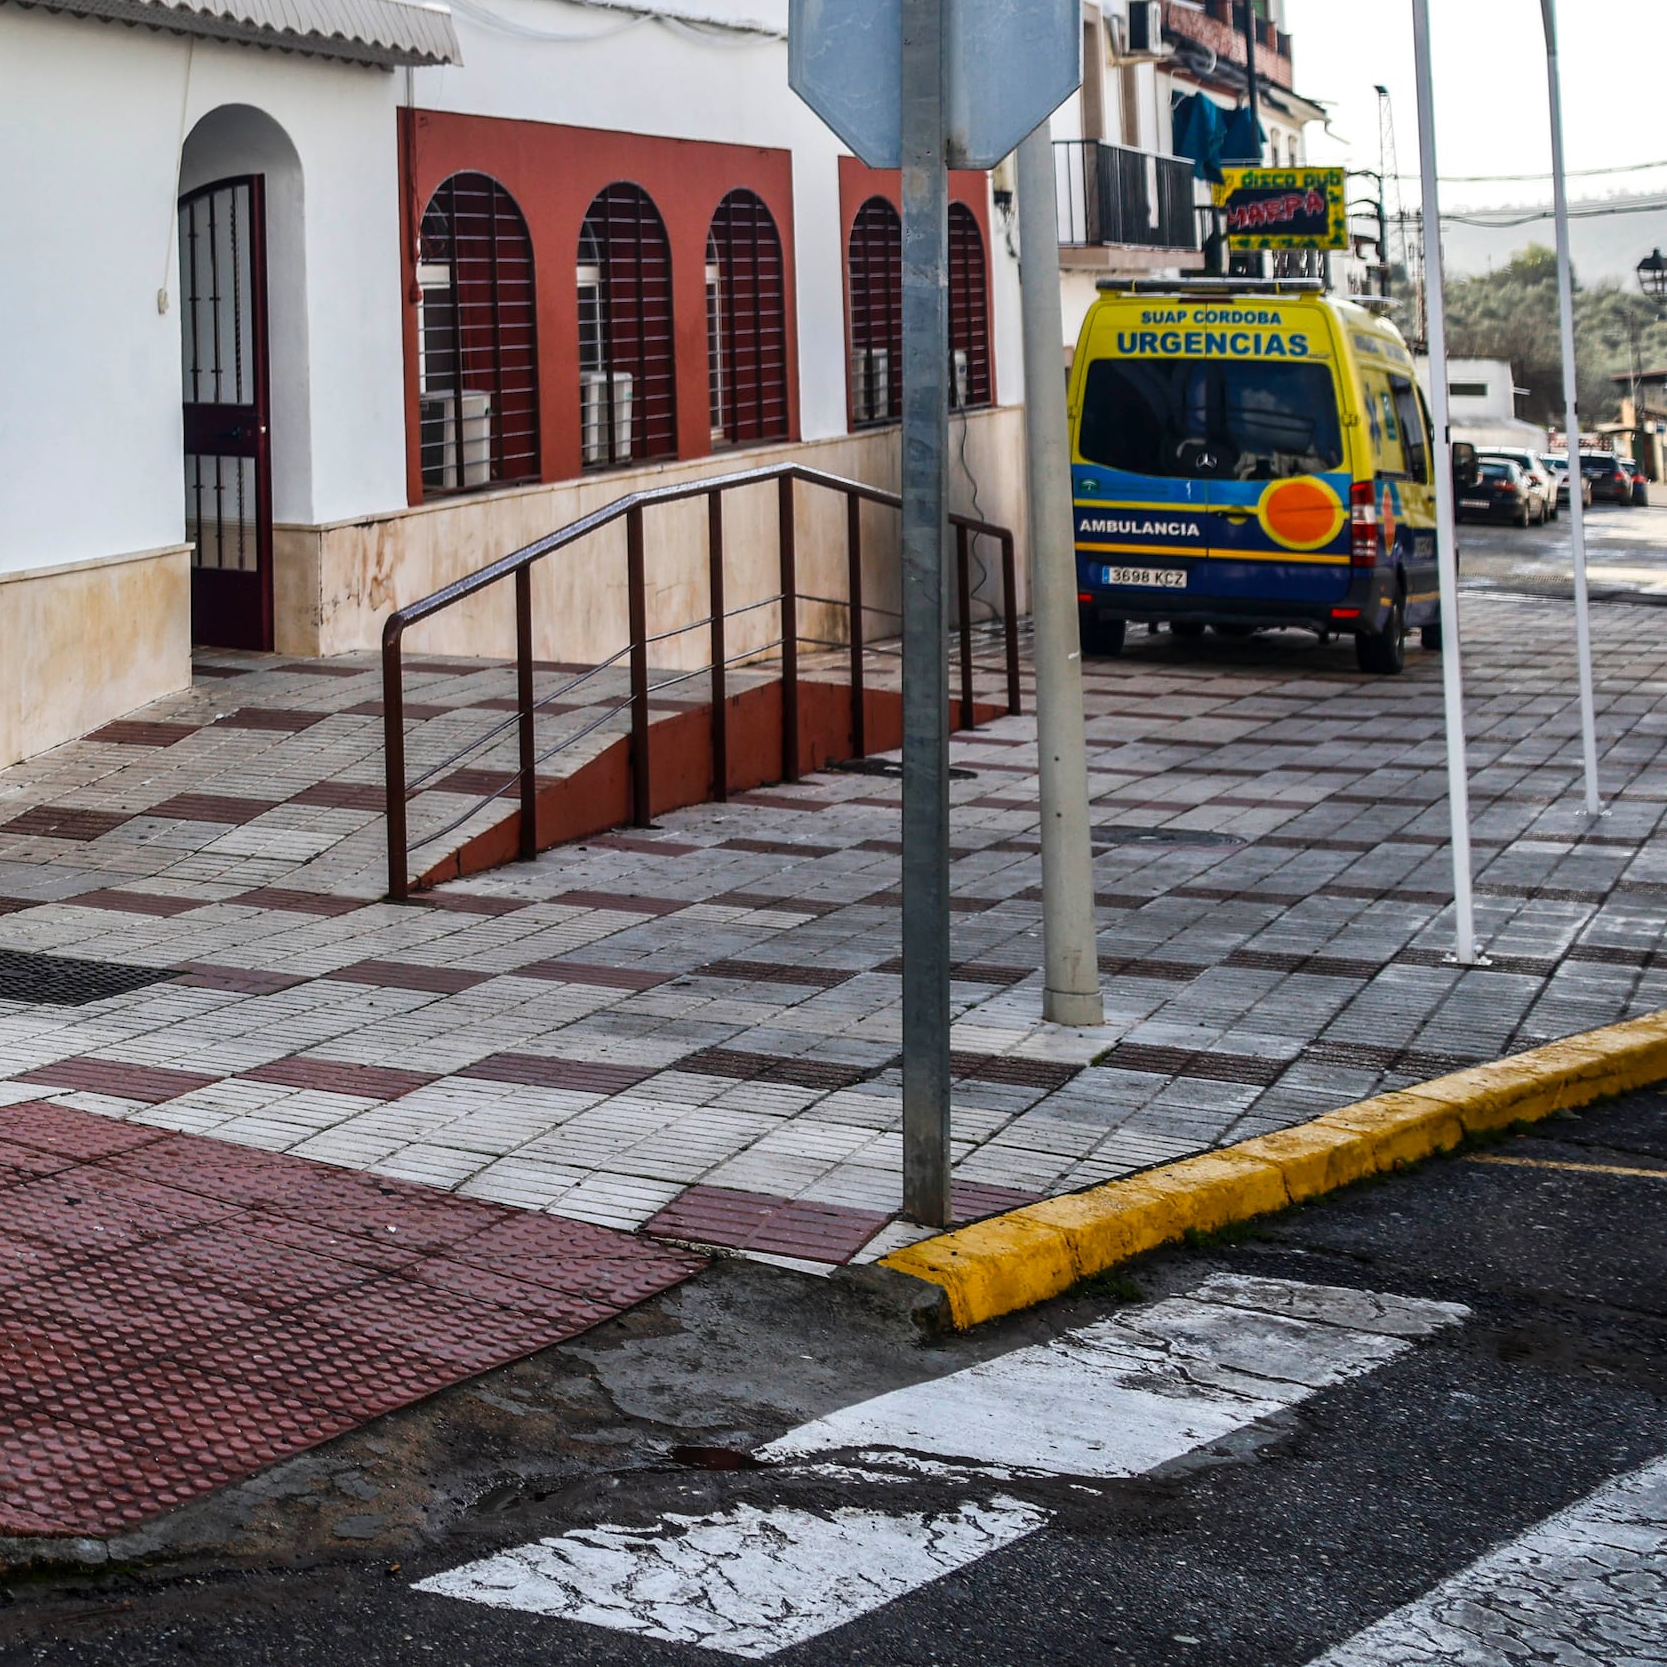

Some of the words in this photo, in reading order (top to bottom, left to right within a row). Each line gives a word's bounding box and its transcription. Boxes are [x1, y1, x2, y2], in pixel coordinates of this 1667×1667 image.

[1241, 170, 1297, 188] disco
[1303, 170, 1341, 188] pub
[1140, 310, 1188, 325] SUAP
[1192, 310, 1282, 326] CORDOBA
[1117, 332, 1309, 357] URGENCIAS
[1079, 519, 1201, 537] AMBULANCIA
[1111, 569, 1150, 584] 3698
[1154, 571, 1184, 587] KCZ
